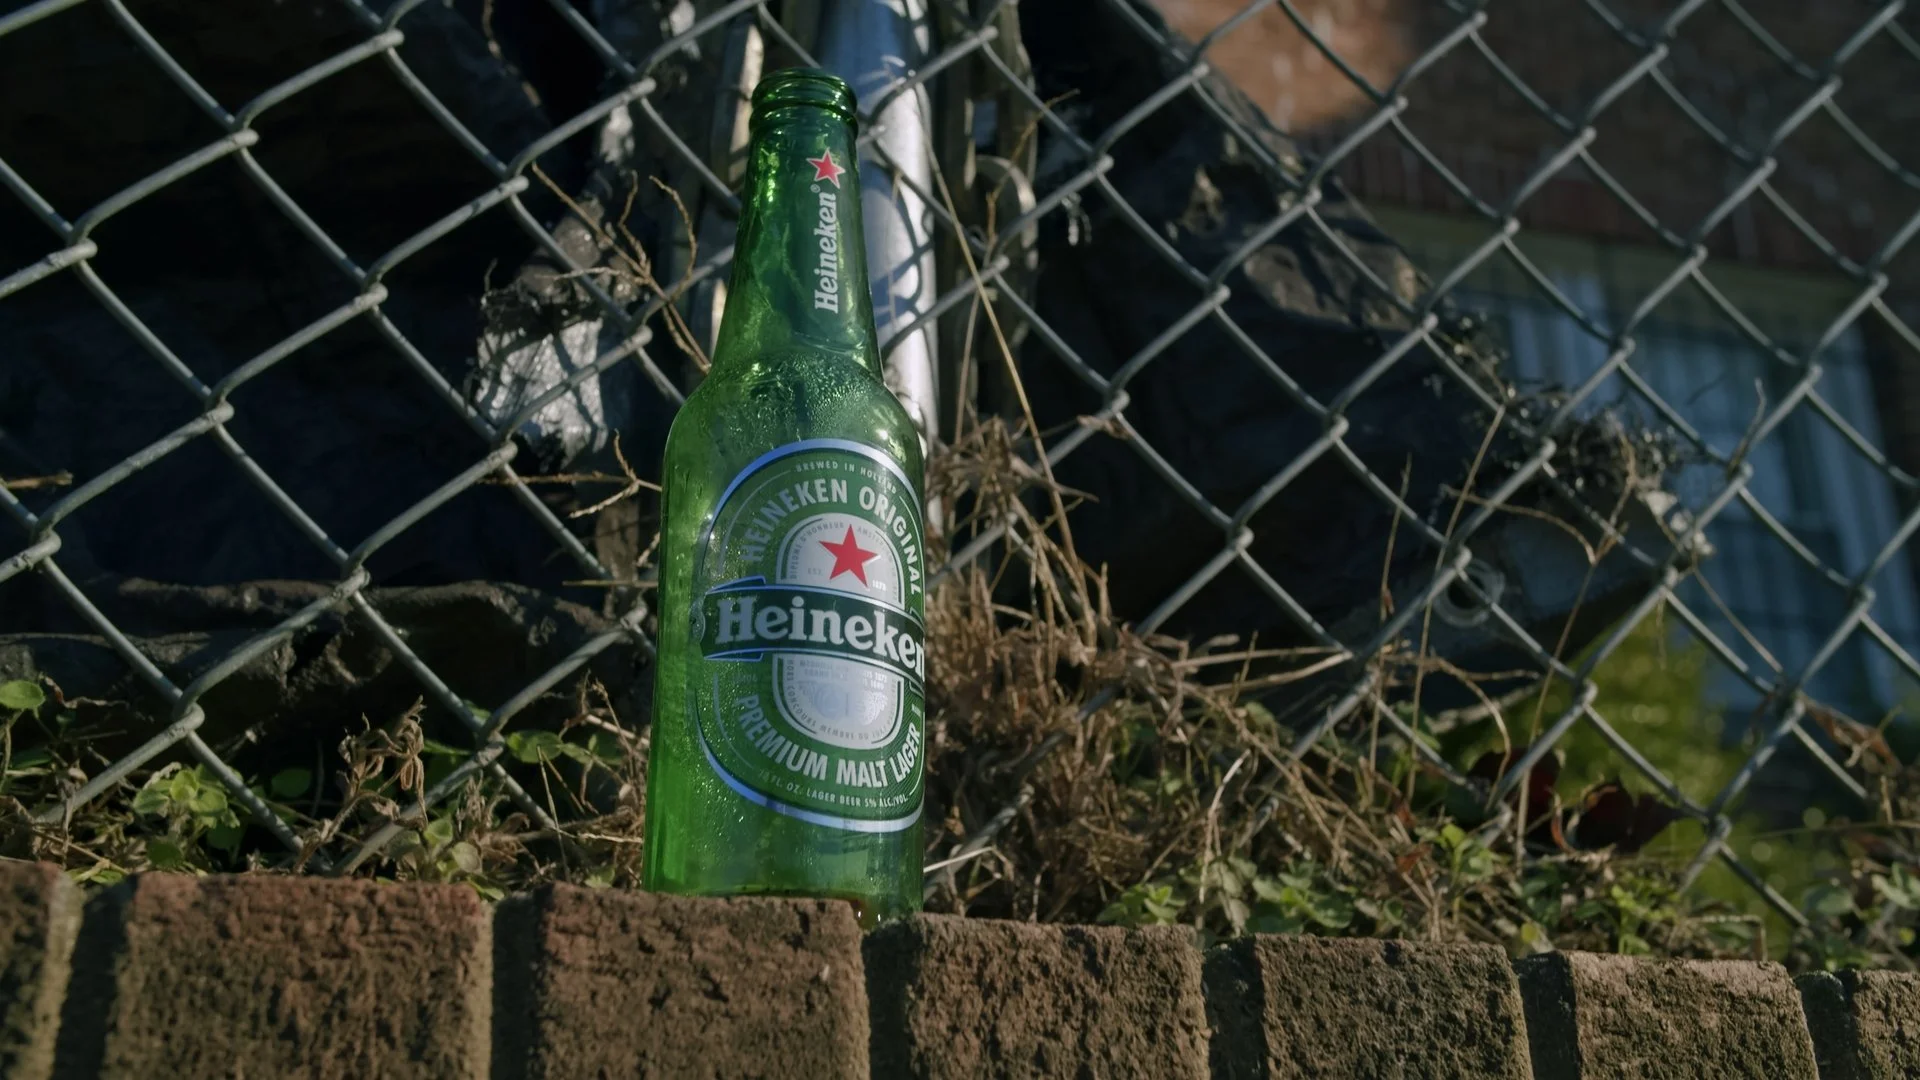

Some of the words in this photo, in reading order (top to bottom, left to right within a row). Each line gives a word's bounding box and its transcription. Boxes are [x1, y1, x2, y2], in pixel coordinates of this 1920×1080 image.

[814, 191, 839, 314] Heineken
[796, 460, 839, 472] BREWED
[844, 462, 856, 473] IN
[739, 478, 848, 563] HEINEKEN
[858, 485, 922, 596] ORIGINAL
[714, 595, 925, 683] Heineken
[737, 693, 829, 781] PREMIUM
[835, 758, 889, 788] MALT
[888, 721, 921, 784] LAGER
[806, 787, 836, 802] LAGER
[839, 794, 862, 807] BEER
